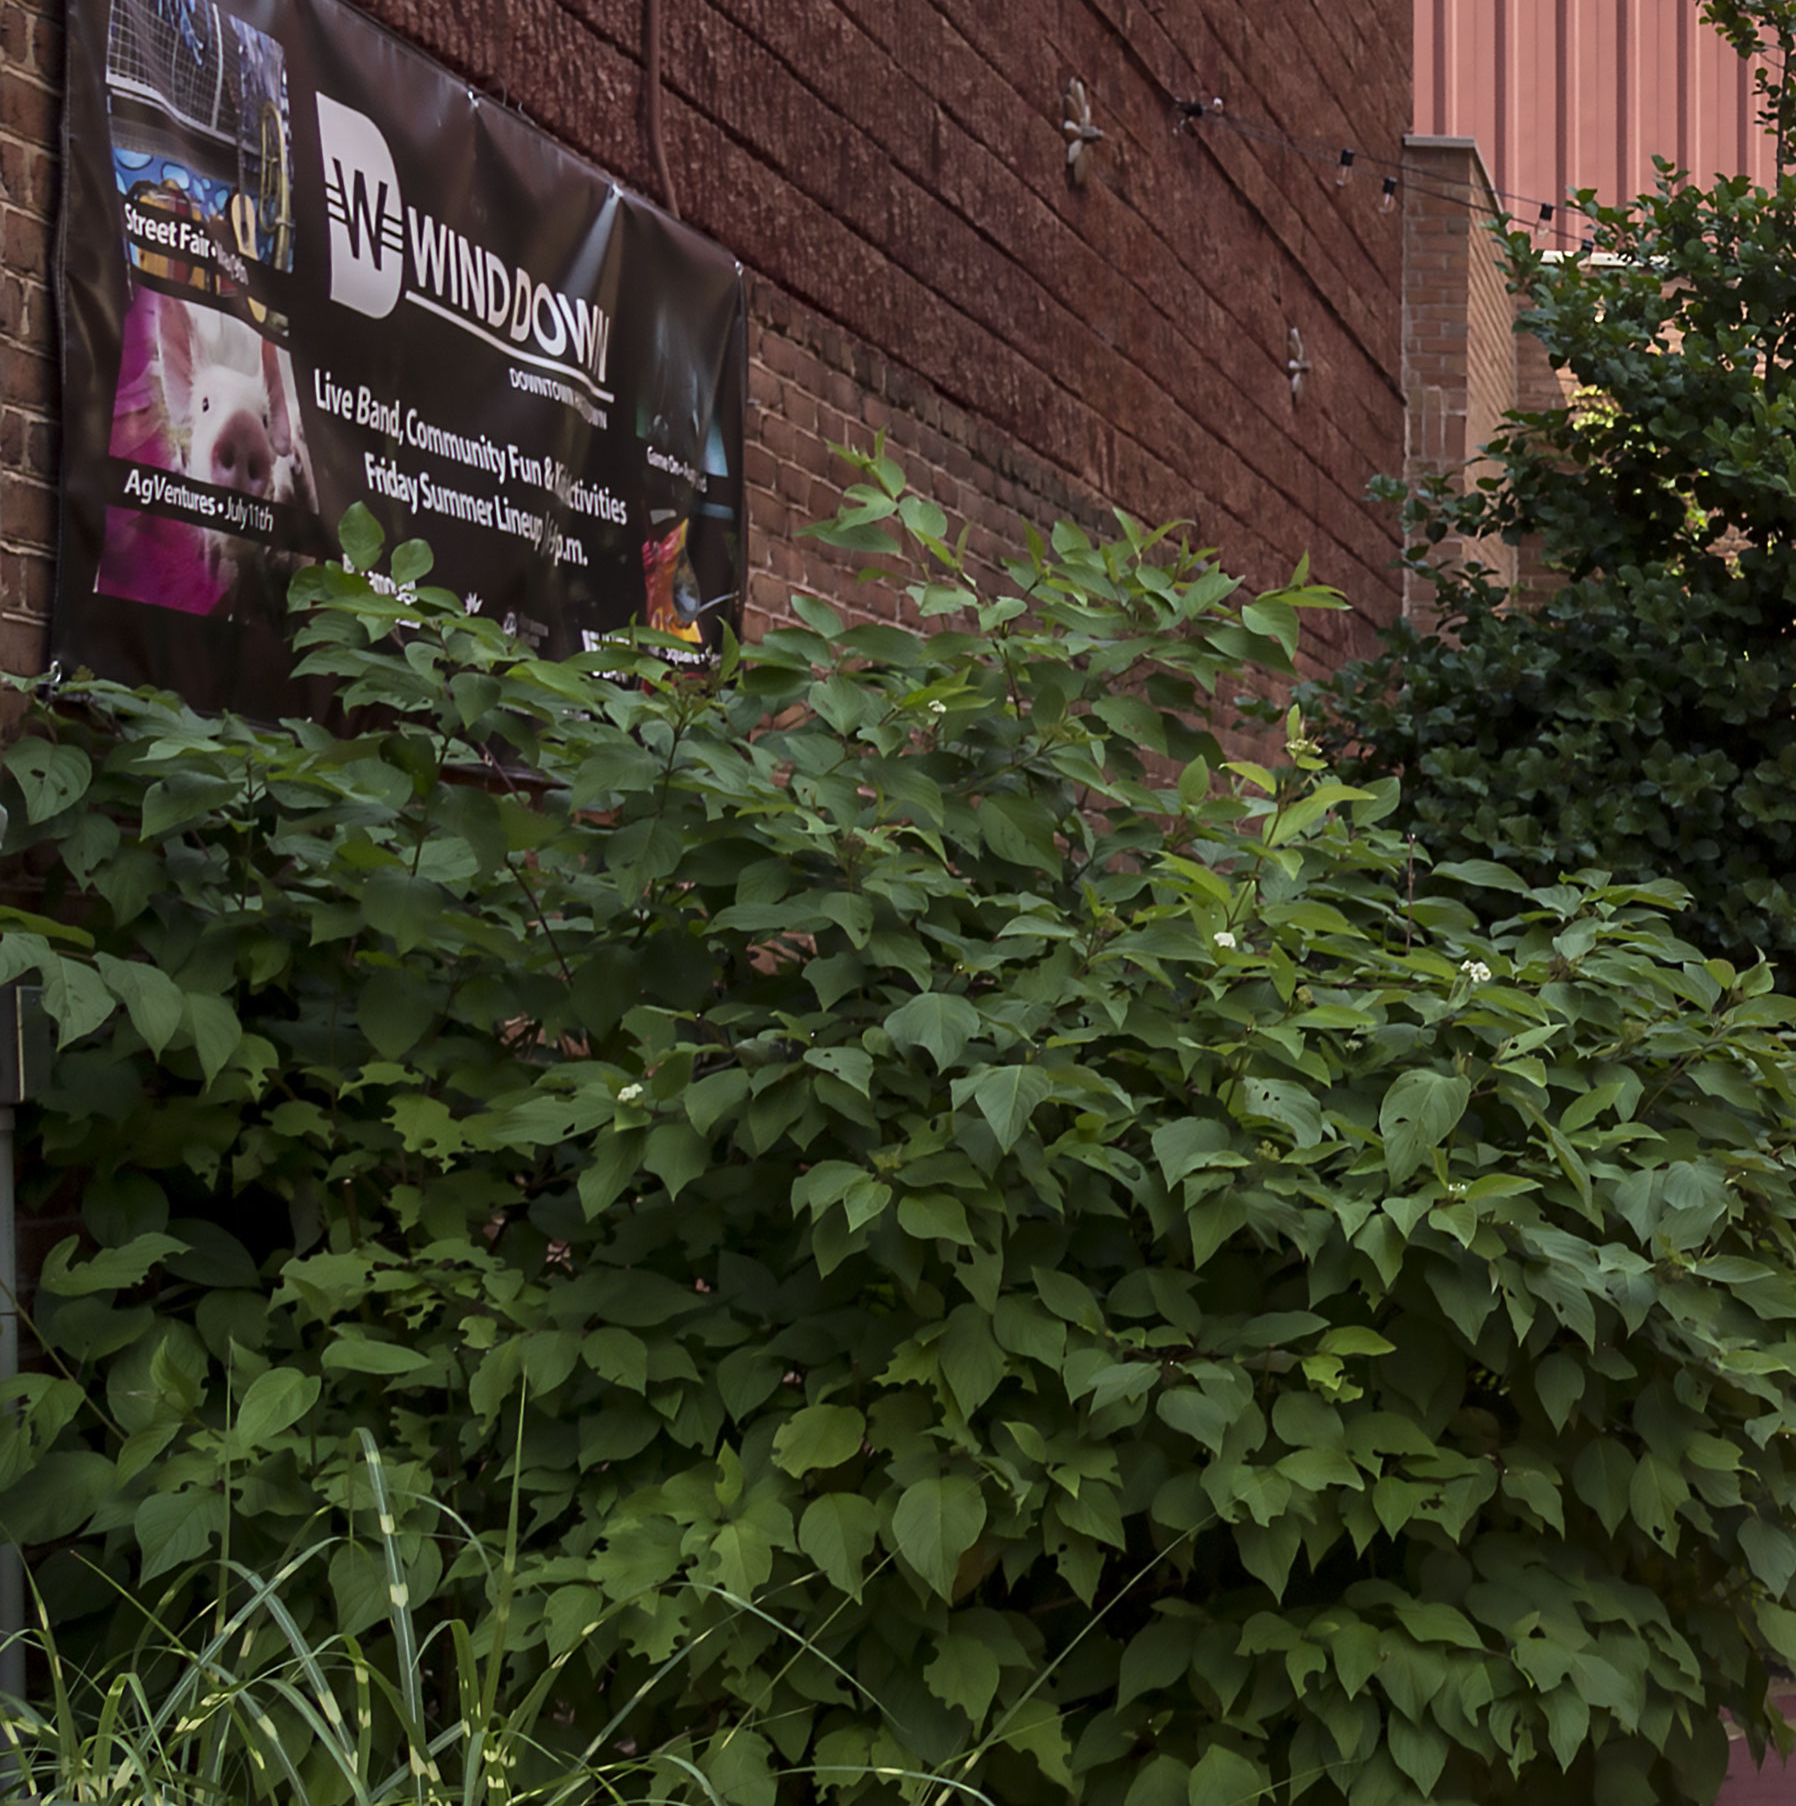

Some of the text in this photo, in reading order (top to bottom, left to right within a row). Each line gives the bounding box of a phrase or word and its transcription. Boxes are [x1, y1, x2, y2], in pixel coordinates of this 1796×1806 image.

[124, 202, 177, 248] Street
[180, 222, 210, 259] Fair
[314, 367, 353, 420] Live
[356, 385, 404, 446] Band,
[405, 408, 507, 485] Community
[507, 444, 542, 487] Fun
[123, 468, 274, 533] AgVentures July 11th
[364, 451, 418, 515] Friday
[419, 472, 493, 528] Summer
[495, 495, 544, 552] Lineup
